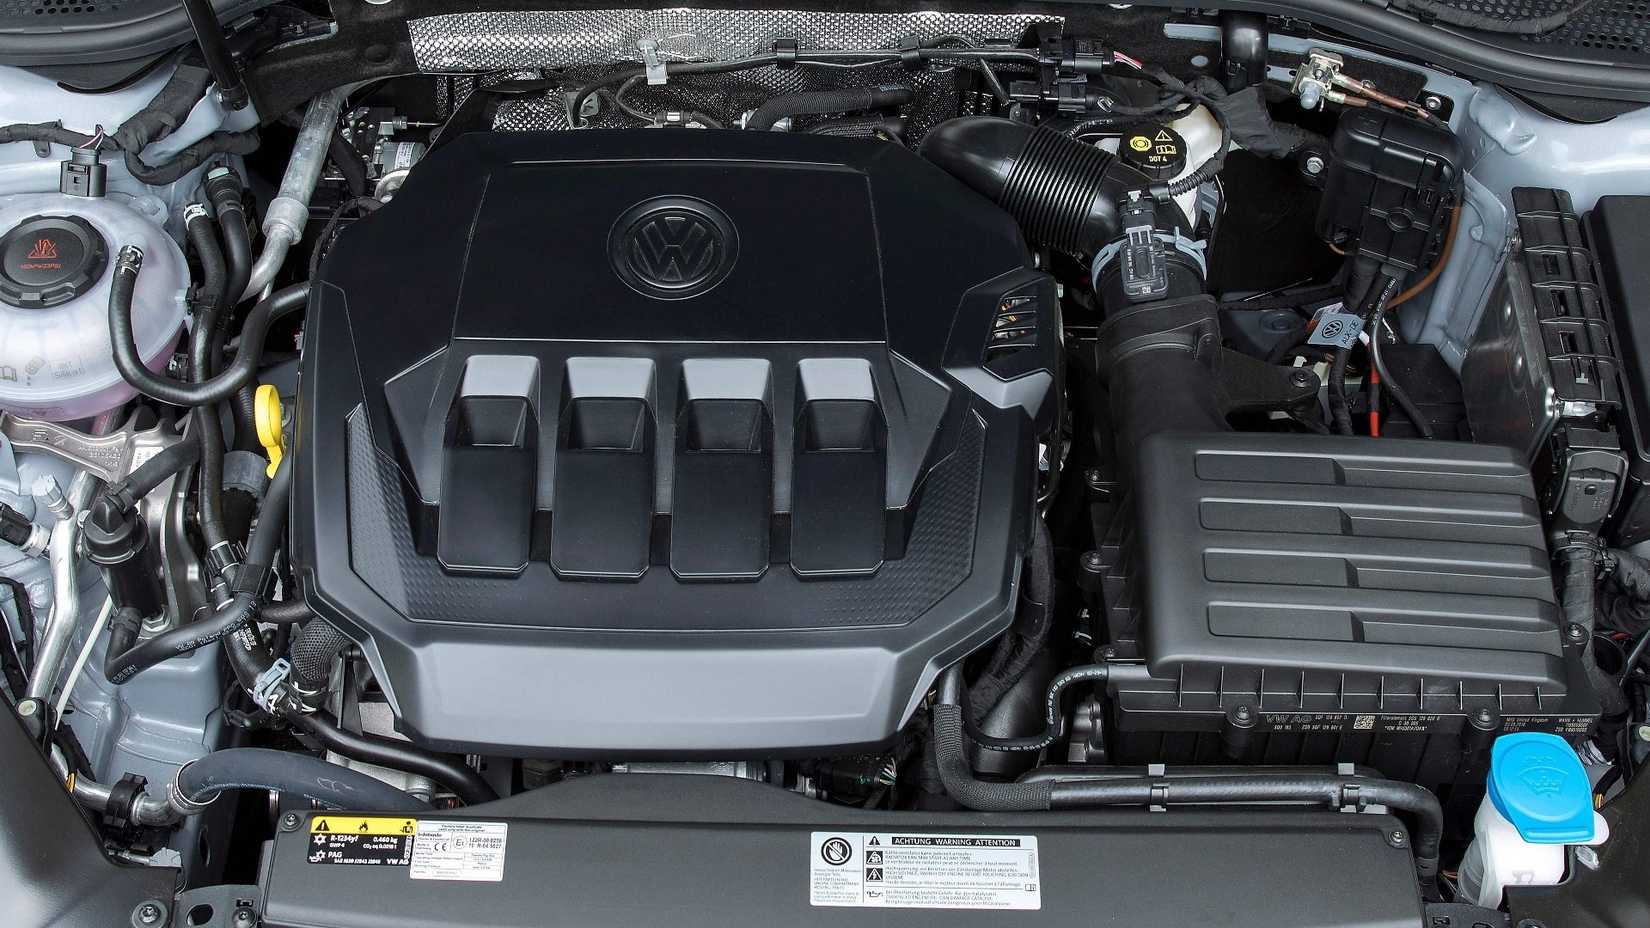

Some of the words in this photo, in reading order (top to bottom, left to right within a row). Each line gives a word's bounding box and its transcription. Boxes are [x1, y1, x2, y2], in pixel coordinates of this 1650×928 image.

[330, 835, 359, 844] R-1234yf
[894, 838, 932, 846] ACHTUNG
[935, 838, 972, 846] WARNING
[975, 839, 1016, 847] ATTENTION
